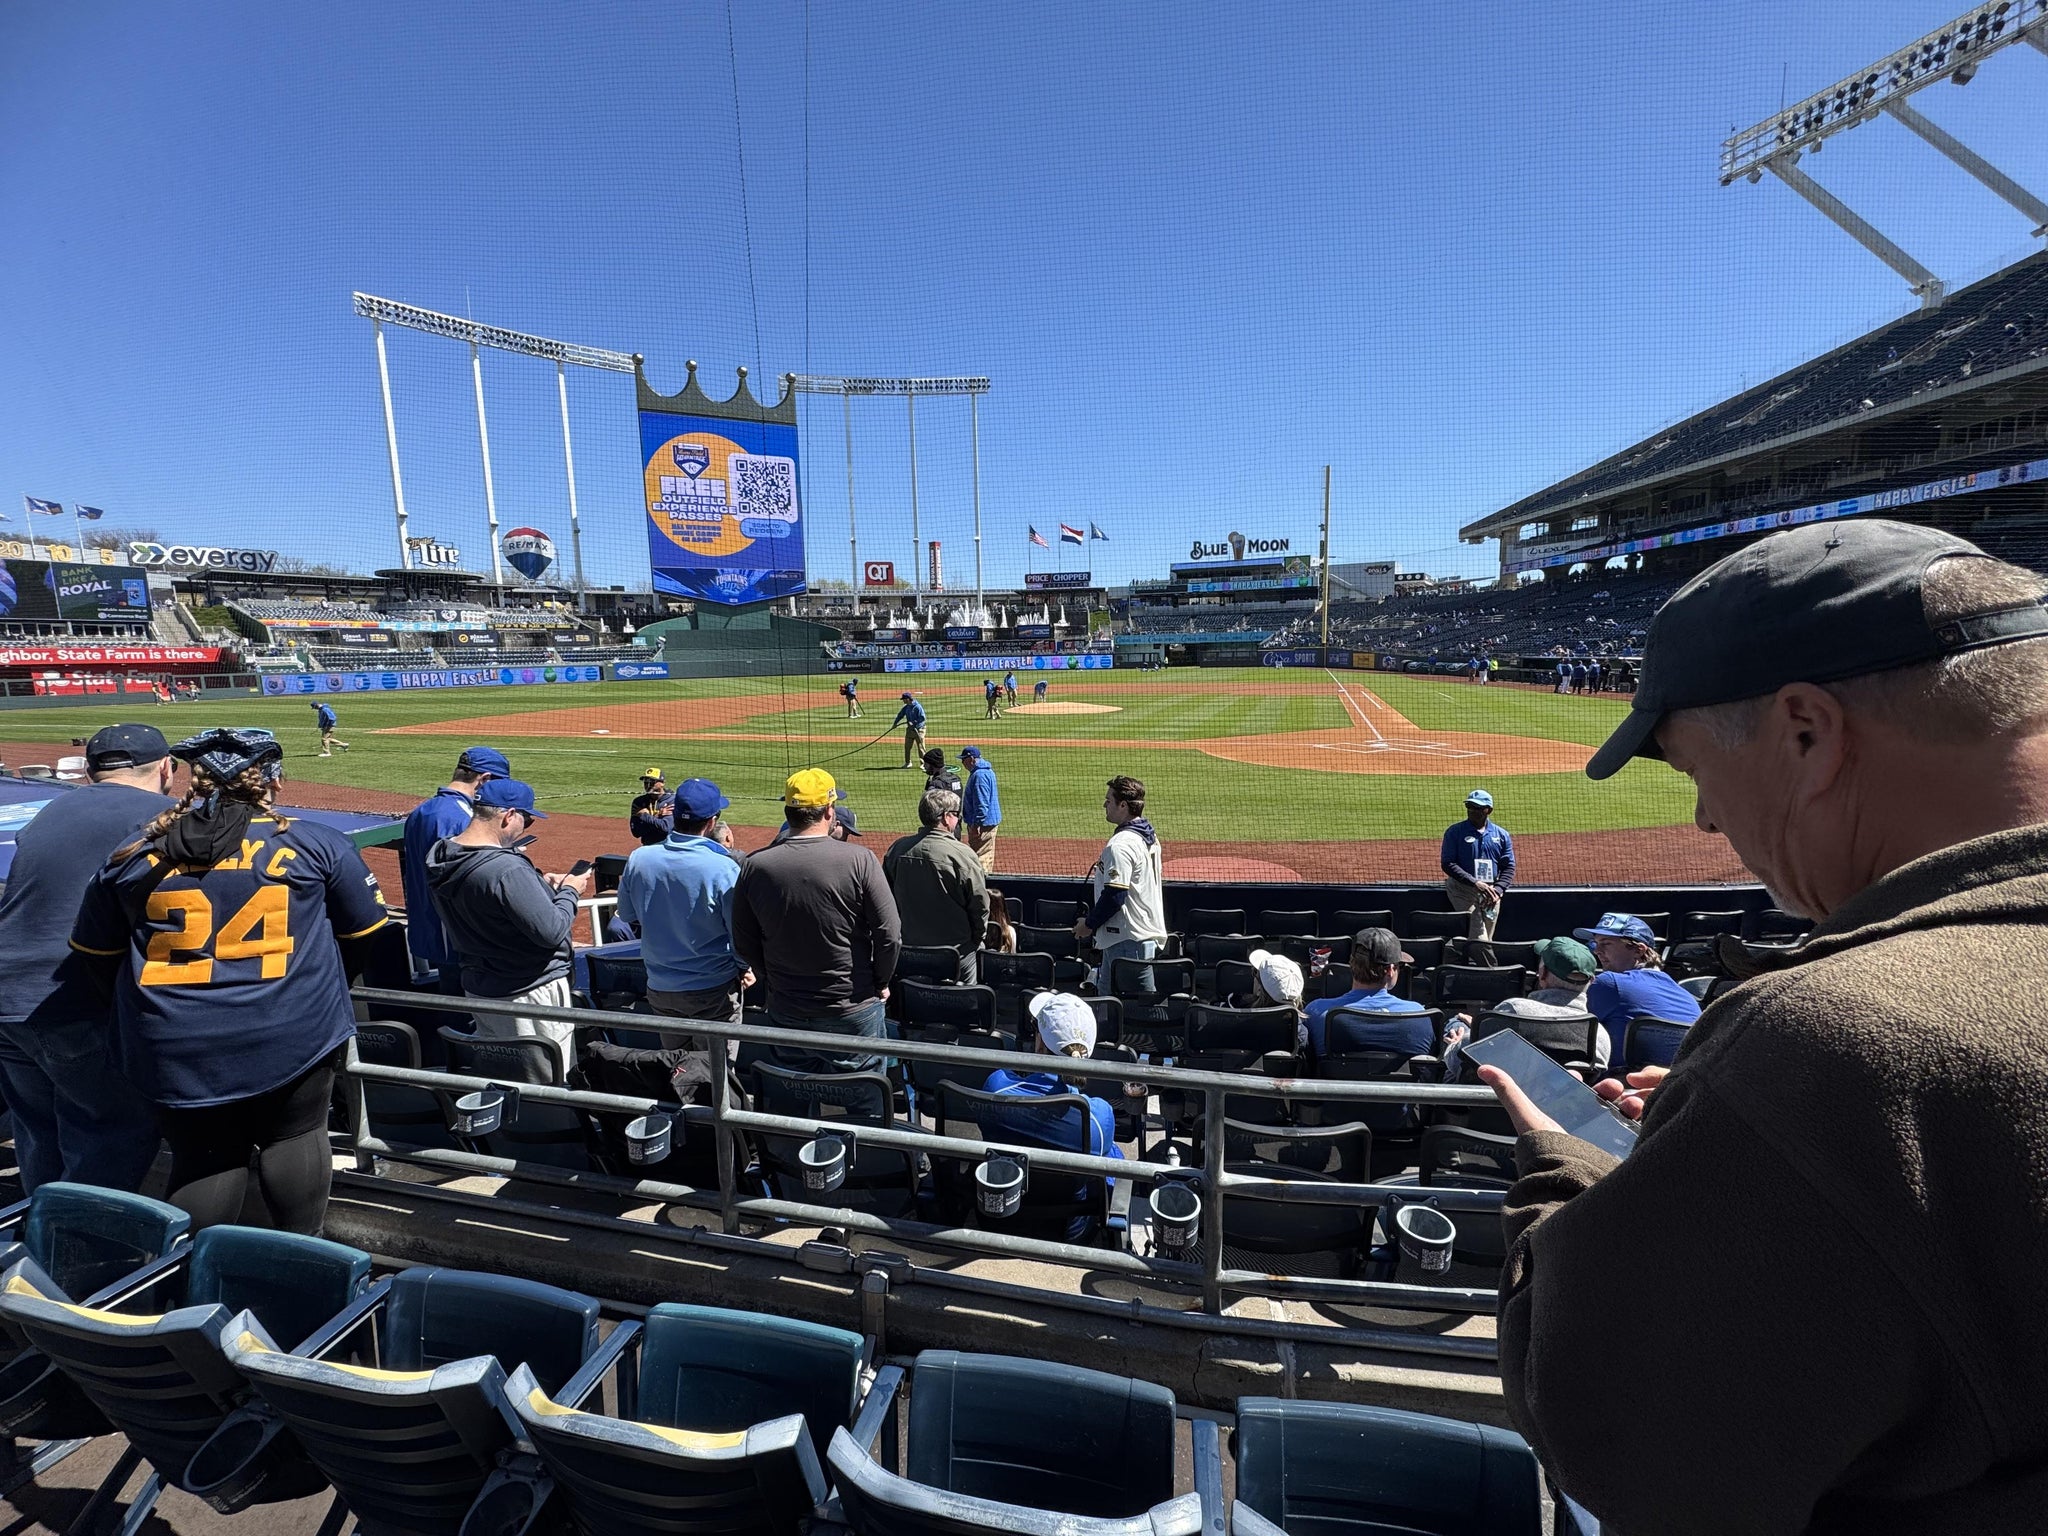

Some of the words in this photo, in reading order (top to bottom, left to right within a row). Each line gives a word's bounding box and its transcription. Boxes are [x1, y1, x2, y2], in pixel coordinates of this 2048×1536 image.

[660, 476, 726, 497] FREE
[1875, 487, 1917, 507] HAPPY
[1923, 473, 1976, 499] EASTER
[662, 495, 726, 505] OUTFIELD
[652, 502, 737, 515] EXPERIENCE
[669, 511, 722, 521] PASSES
[509, 540, 548, 552] RE/MAX
[1190, 540, 1228, 560] BLUE
[1248, 538, 1289, 553] MOON
[1538, 545, 1570, 553] LEXUS
[168, 546, 278, 572] evergy
[419, 543, 460, 567] Lite
[61, 566, 93, 577] BANK
[867, 564, 890, 582] QT
[1027, 574, 1049, 582] PRICE
[1053, 573, 1089, 581] CHOPPER
[59, 580, 112, 597] ROYAL
[62, 576, 84, 586] LIKE
[0, 650, 53, 664] ghbor,
[57, 649, 101, 660] State
[105, 649, 146, 660] Farm
[149, 649, 164, 659] is
[164, 649, 207, 660] there.
[856, 645, 912, 654] FOUNTAIN
[915, 644, 944, 653] DECK
[964, 659, 995, 670] HAPPY
[998, 657, 1033, 669] EASTER
[402, 672, 447, 687] HAPPY
[452, 668, 498, 686] EASTER
[266, 847, 297, 877] C
[140, 884, 294, 986] 24
